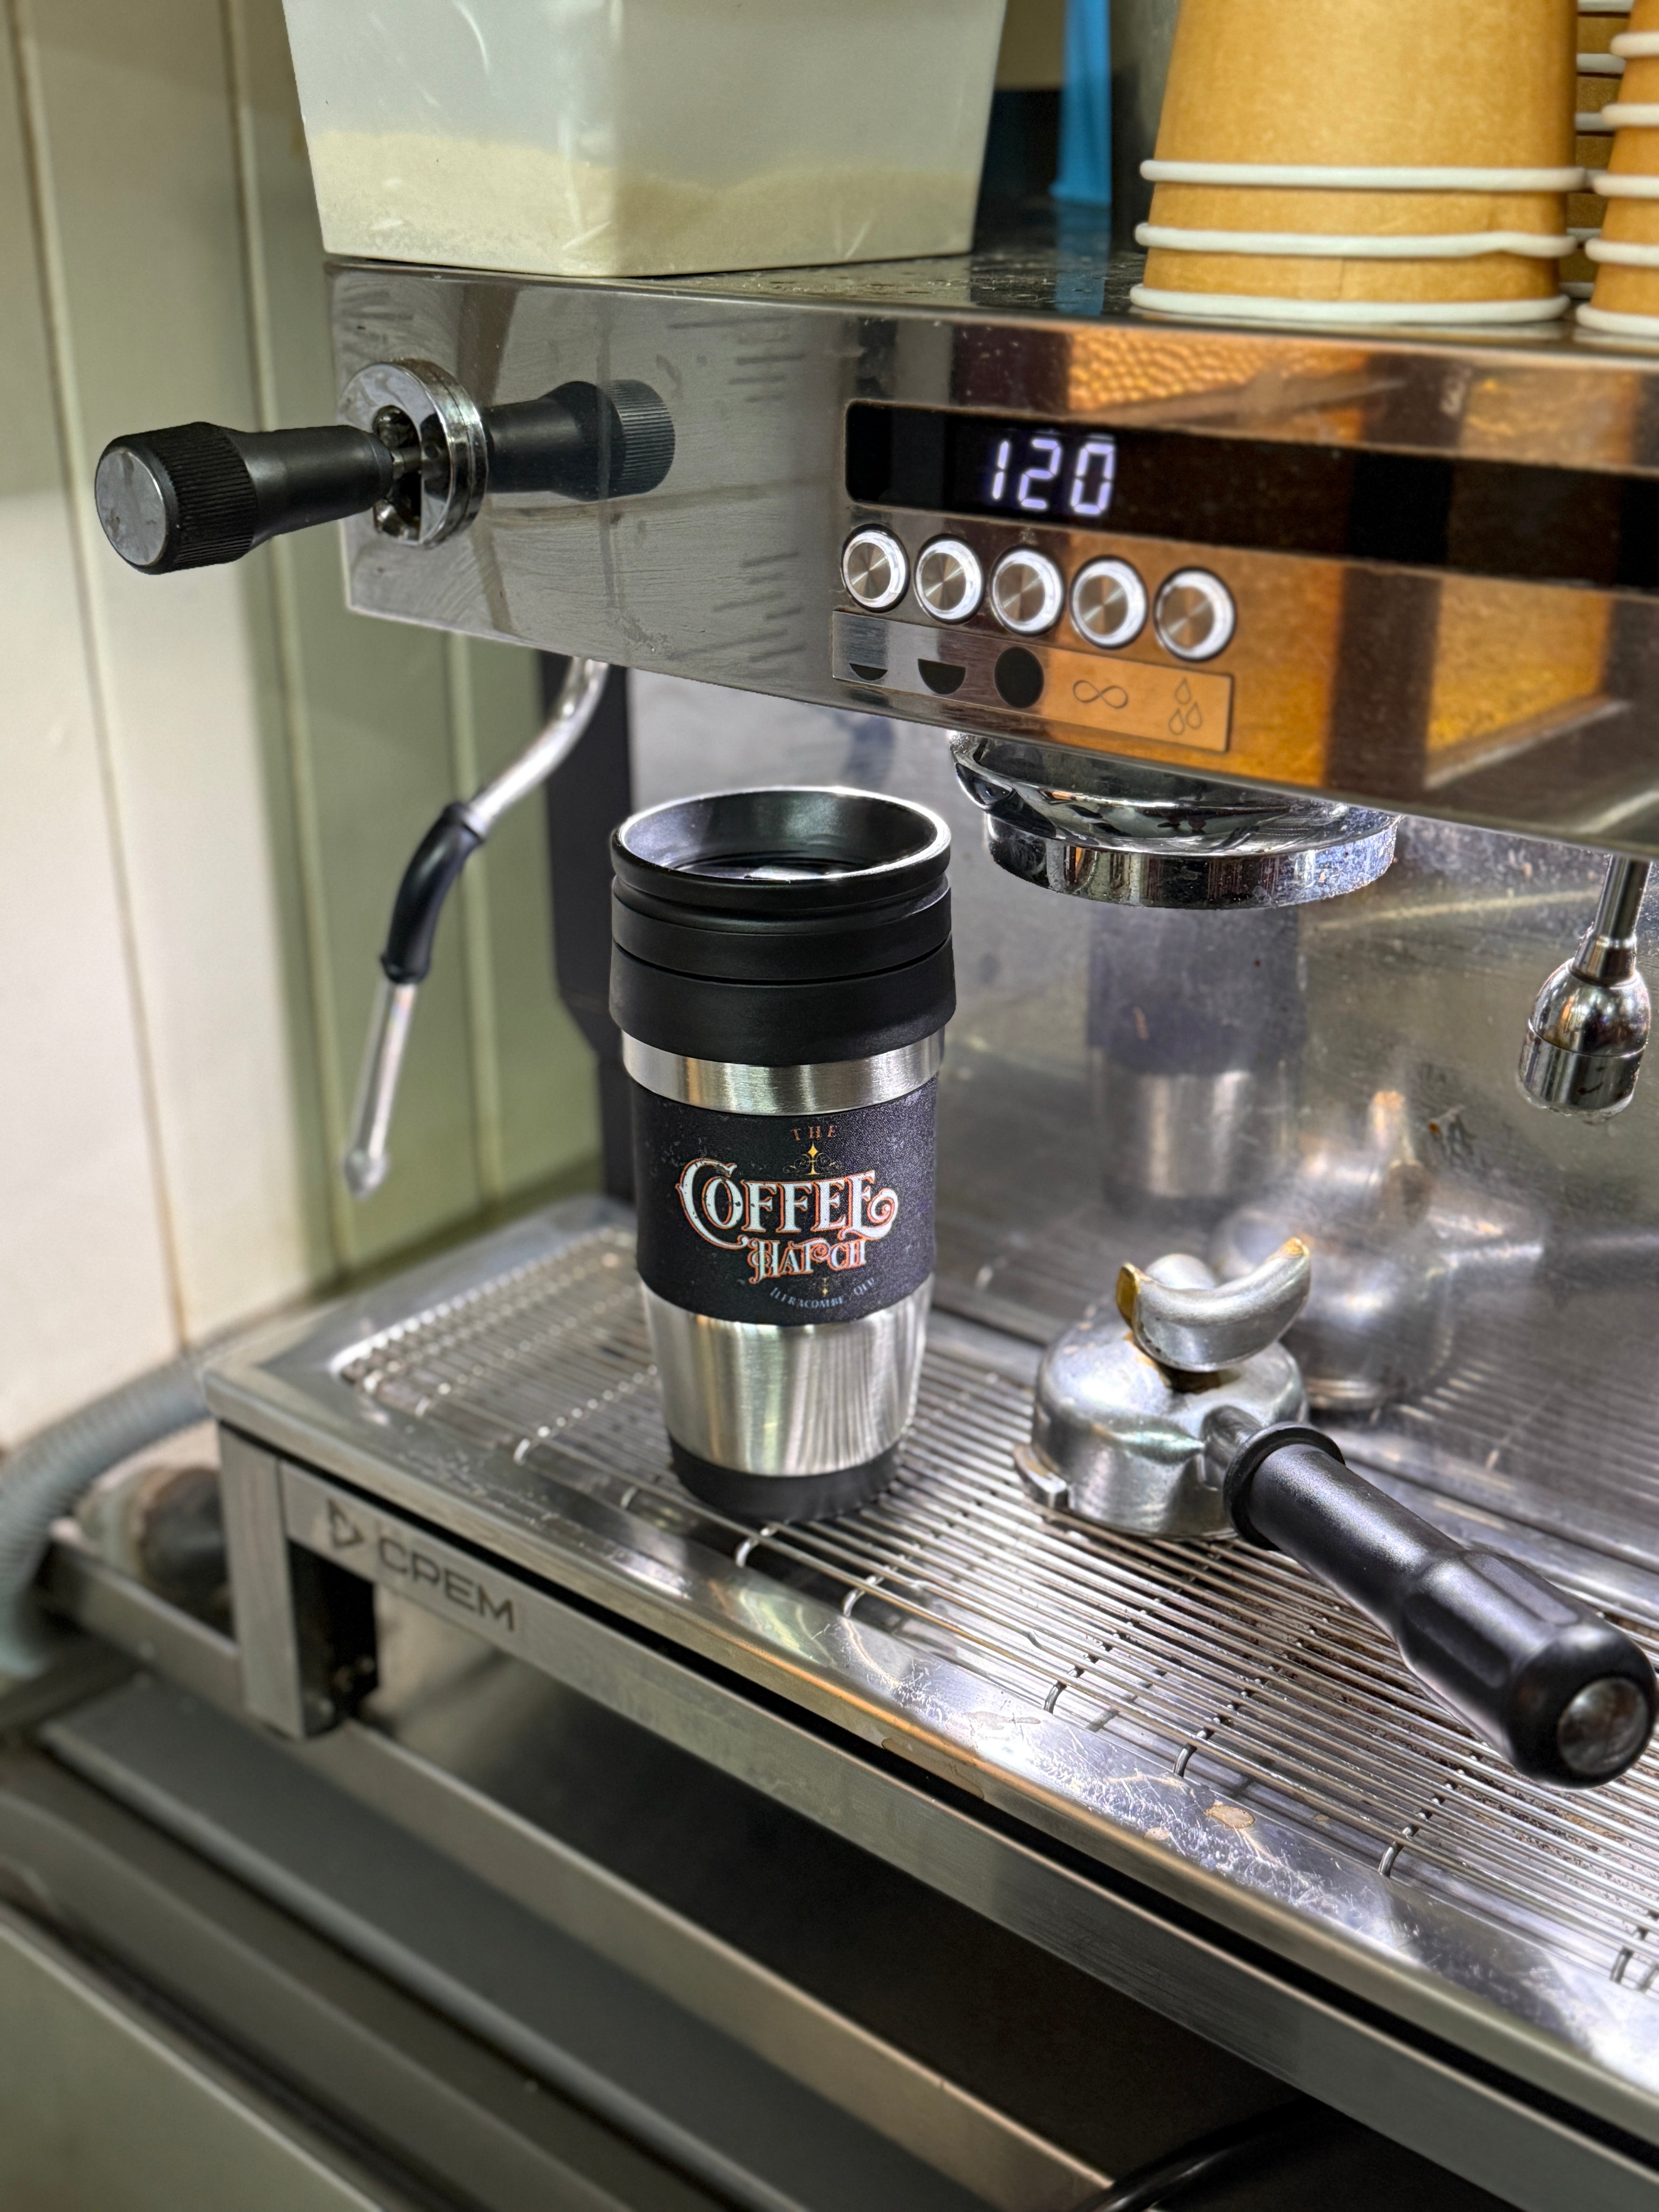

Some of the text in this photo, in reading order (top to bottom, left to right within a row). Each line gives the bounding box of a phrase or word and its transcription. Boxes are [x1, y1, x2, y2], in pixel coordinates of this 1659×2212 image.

[991, 438, 1116, 515] 120
[790, 1124, 836, 1141] THE
[675, 1158, 899, 1250] COFFEE
[748, 1237, 867, 1284] HATCH
[379, 1537, 514, 1630] CREM
